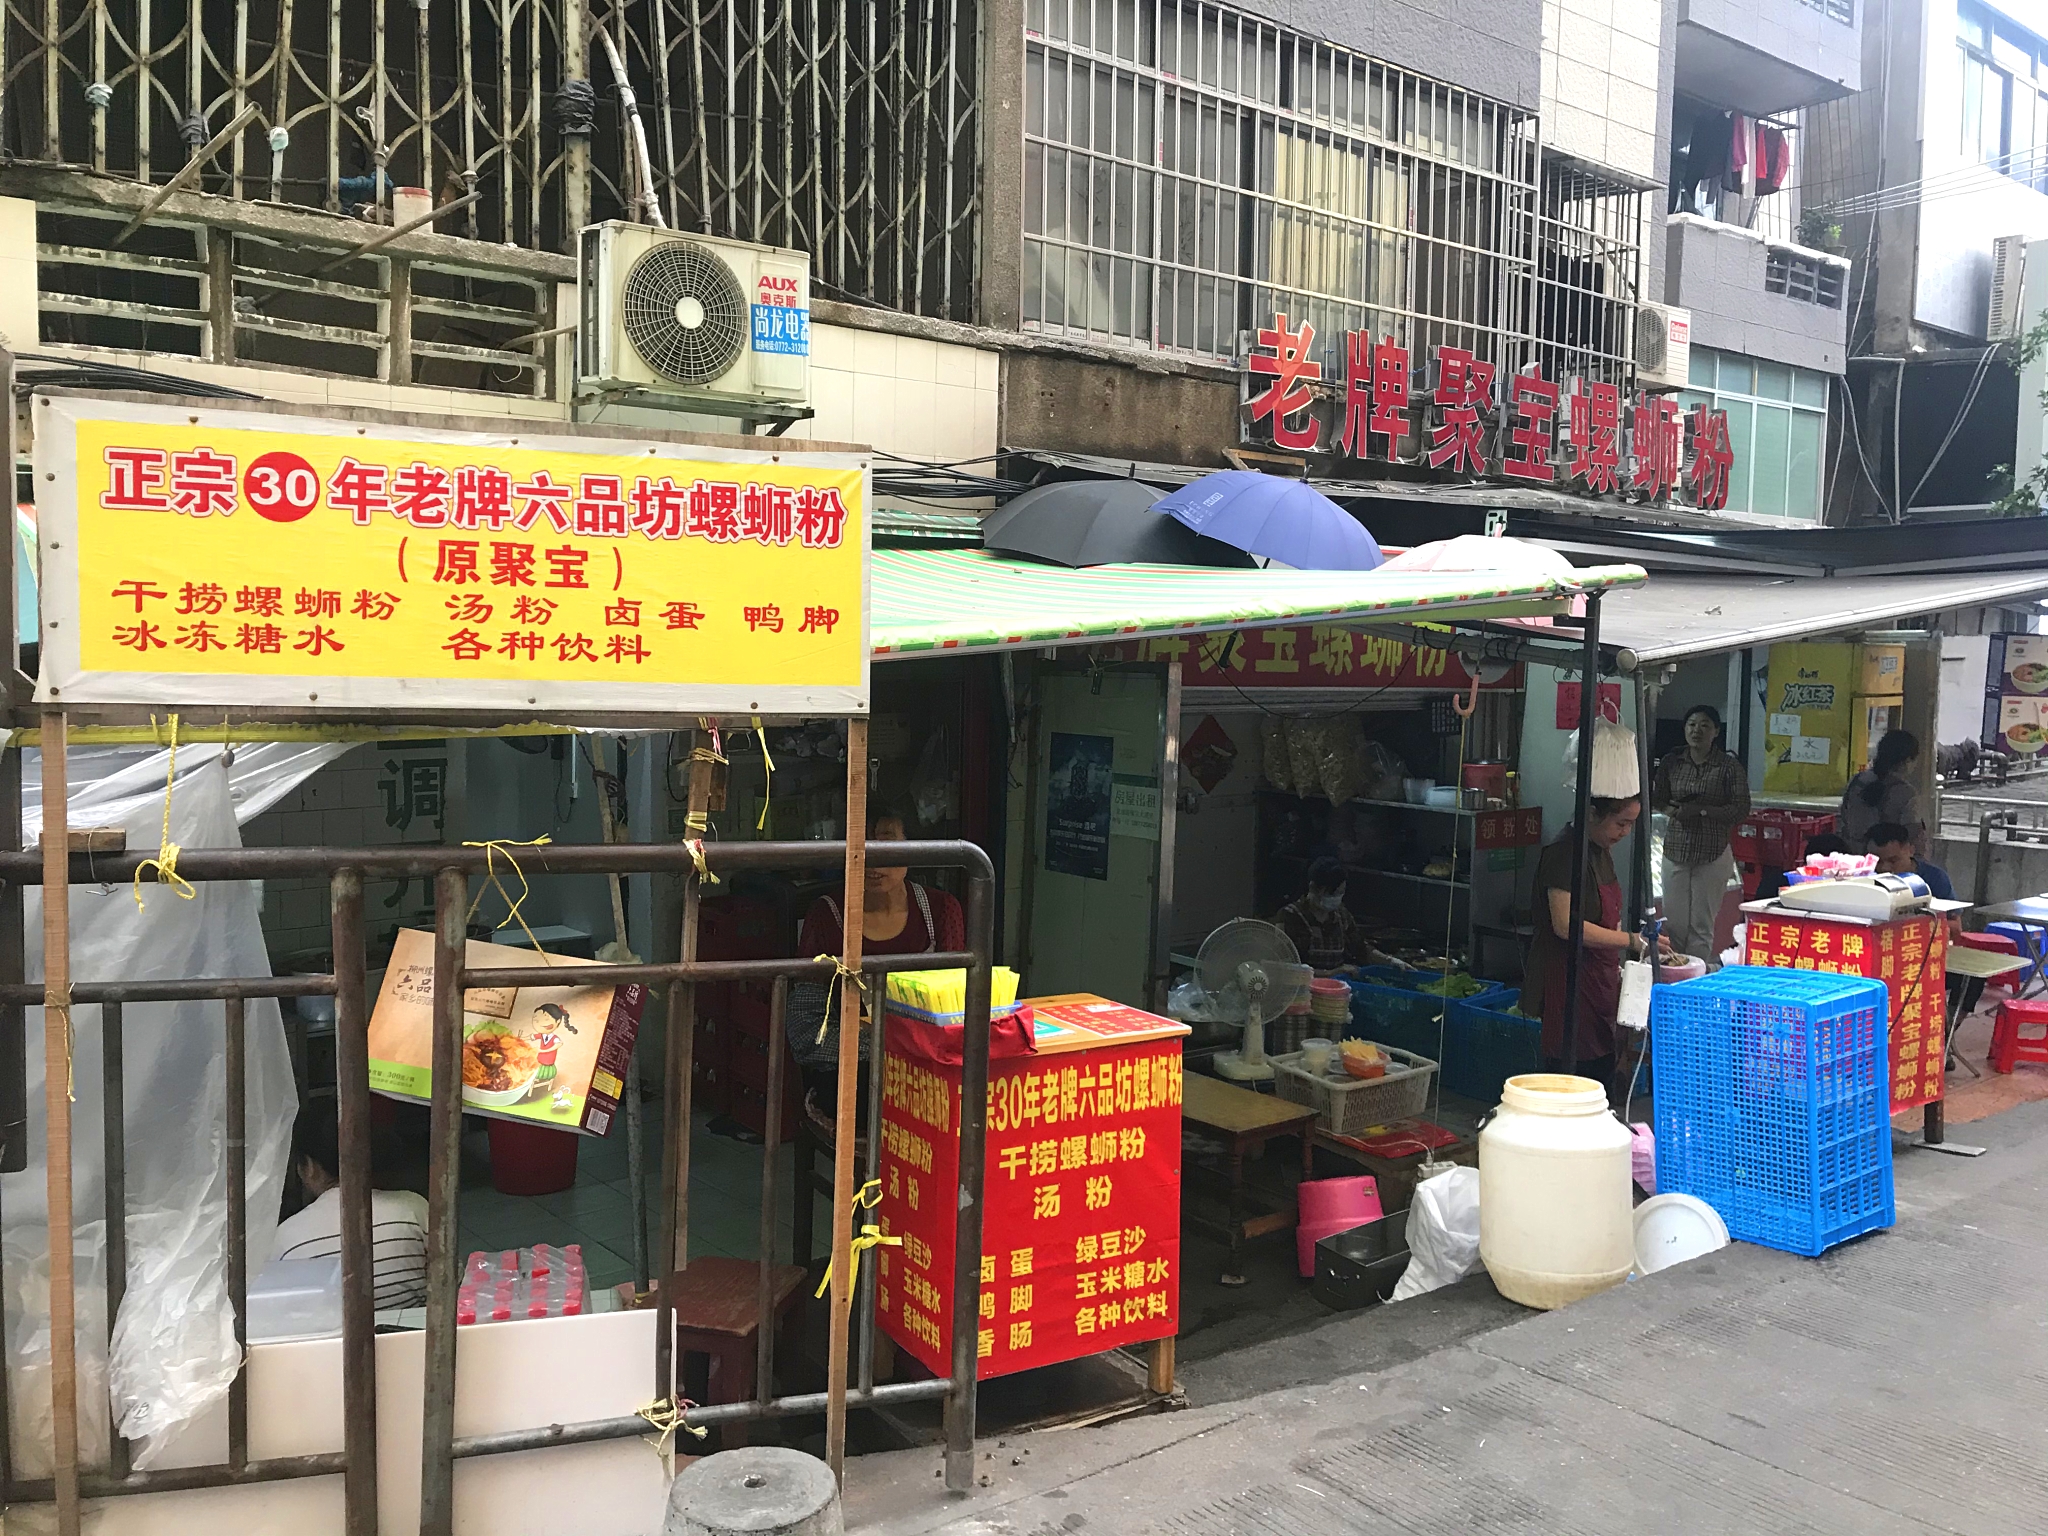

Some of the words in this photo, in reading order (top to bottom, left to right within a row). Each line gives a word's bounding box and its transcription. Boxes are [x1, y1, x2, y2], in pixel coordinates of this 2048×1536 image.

[757, 275, 798, 292] AUX
[760, 292, 796, 309] 奥克斯
[754, 307, 809, 341] 尚龙电器
[1247, 312, 1735, 512] 老牌聚宝螺蛳粉
[102, 446, 848, 548] 正宗30年老牌六品坊螺蛳粉
[397, 541, 624, 592] （原聚宝）
[112, 578, 401, 623] 干捞螺蛳粉
[444, 592, 558, 626] 汤粉
[604, 596, 706, 630] 卤蛋
[743, 605, 841, 635] 鸭脚
[112, 622, 346, 656] 冰冻糖水
[441, 627, 652, 664] 各种饮料
[1112, 622, 1448, 677] 牌聚宝螺蛳粉
[1780, 682, 1835, 712] 冰红茶
[1115, 790, 1156, 808] 房屋出租
[1750, 922, 1864, 958] 正宗老牌
[1880, 928, 1895, 979] 猪脚
[397, 974, 433, 994] 六品
[1894, 922, 1923, 1101] 正宗老牌聚宝螺蛳粉
[1924, 993, 1942, 1098] 干捞螺蛳粉
[957, 1055, 1182, 1137] 30年老牌六品坊螺蛳粉
[880, 1116, 933, 1175] 干捞螺蛳粉
[998, 1126, 1146, 1181] 干捞螺蛳粉
[889, 1164, 919, 1211] 汤粉
[1032, 1175, 1114, 1221] 汤粉
[903, 1229, 933, 1271] 绿豆沙
[979, 1247, 1035, 1285] 卤蛋
[1075, 1226, 1147, 1266] 绿豆沙
[903, 1266, 942, 1316] 玉米糖水
[978, 1284, 1034, 1320] 鸭脚
[1075, 1256, 1171, 1300] 玉米糖水
[903, 1301, 942, 1354] 各种饮料
[976, 1321, 1034, 1360] 香肠
[1074, 1290, 1169, 1338] 各种饮料
